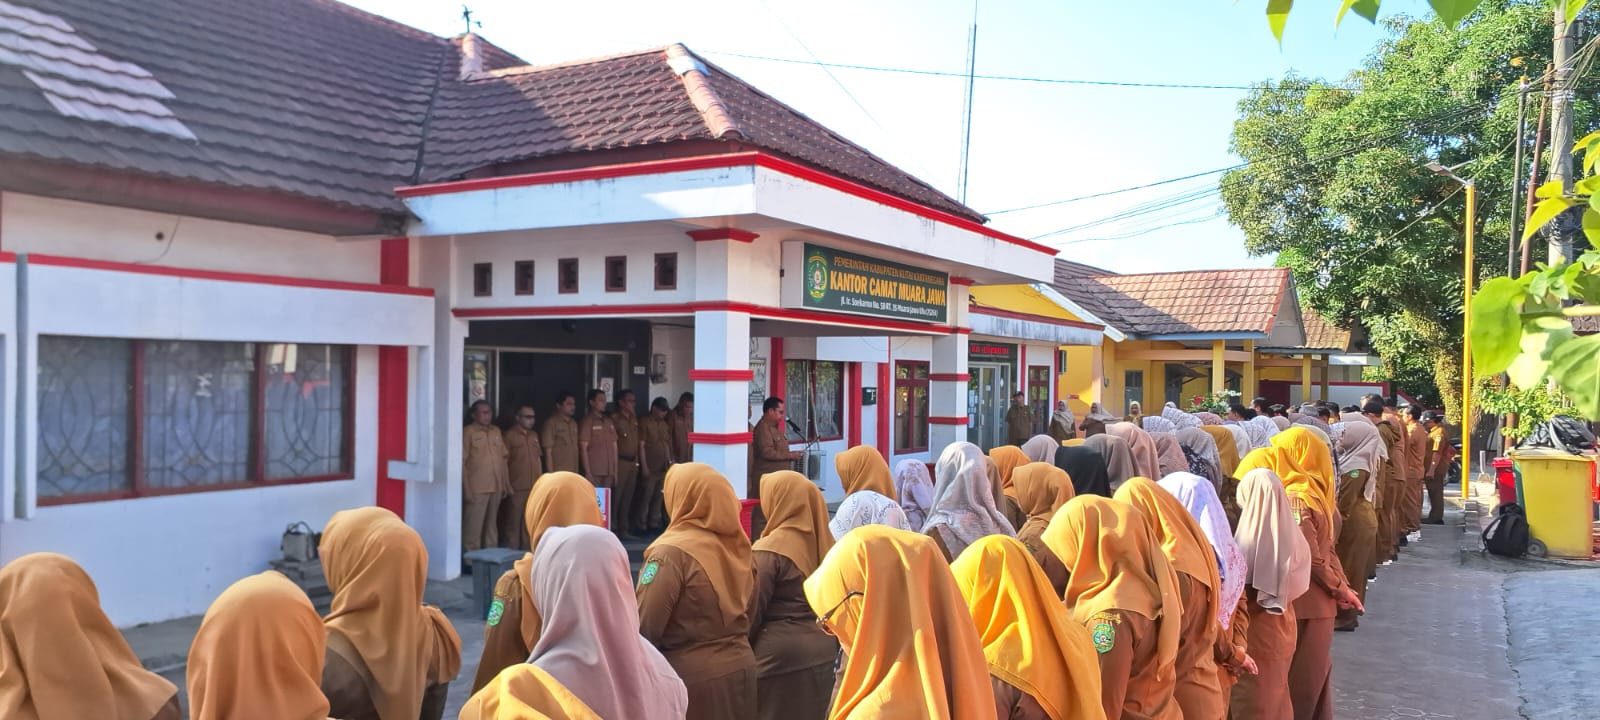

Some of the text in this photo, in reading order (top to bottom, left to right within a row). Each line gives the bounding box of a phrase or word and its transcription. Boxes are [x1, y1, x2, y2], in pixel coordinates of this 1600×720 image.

[869, 263, 897, 276] KABUPATEN
[830, 270, 945, 306] KANTOR CAMAT MUARA JAWA
